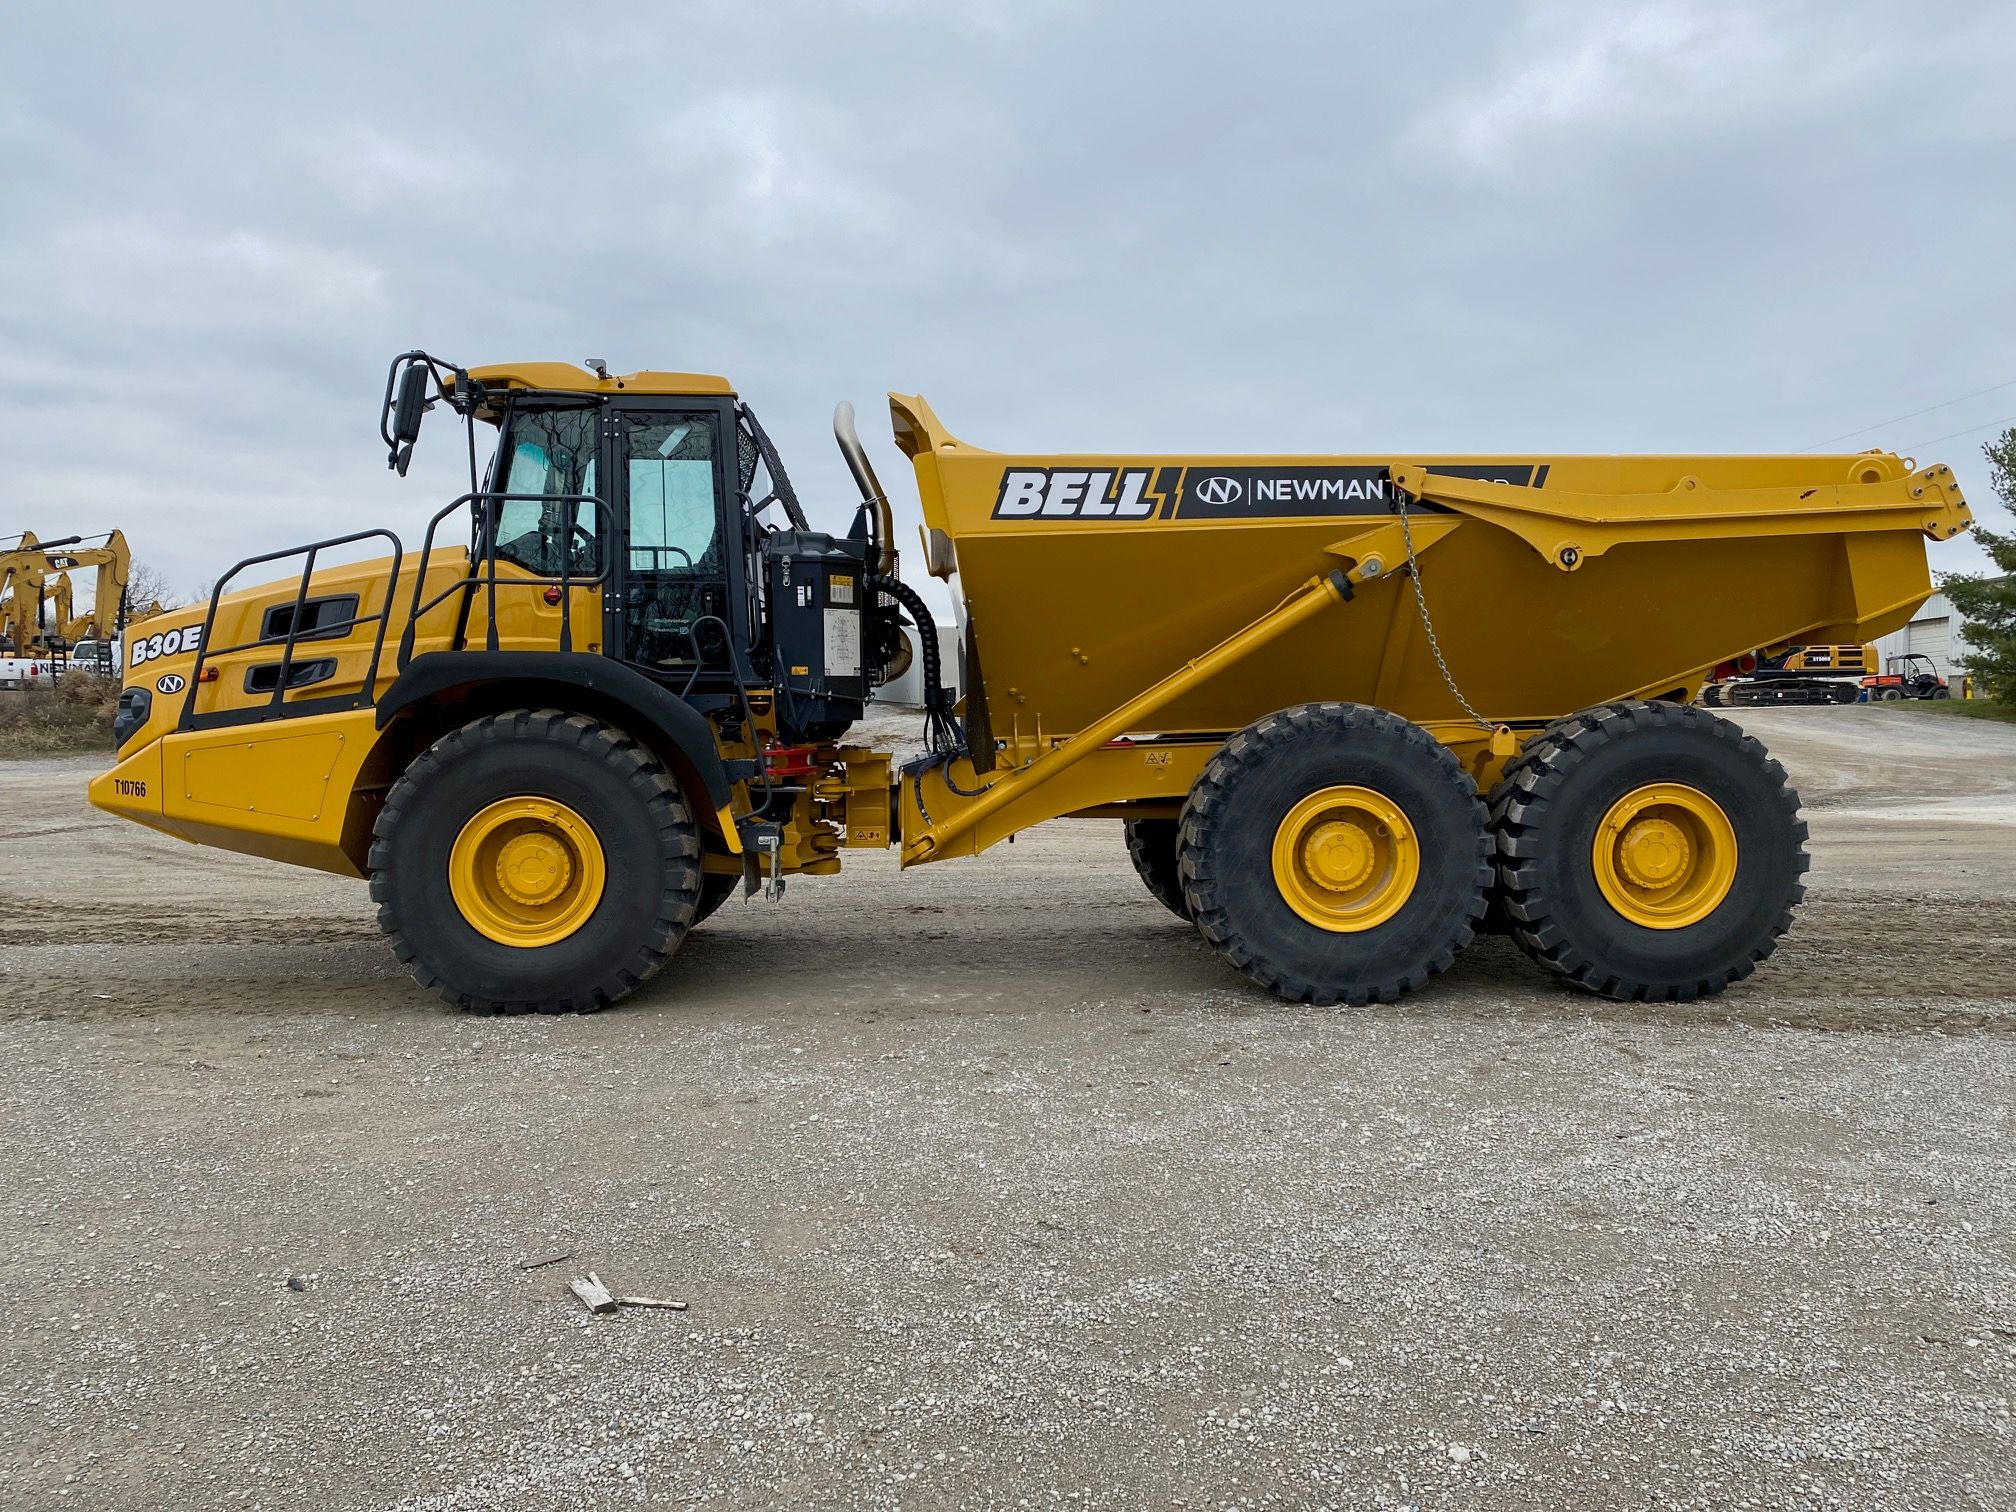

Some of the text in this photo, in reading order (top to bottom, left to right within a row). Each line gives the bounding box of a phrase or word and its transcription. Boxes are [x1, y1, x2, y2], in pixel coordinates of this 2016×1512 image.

[998, 472, 1153, 516] BELL
[1257, 479, 1384, 501] NEWMAN
[54, 557, 69, 569] CAT
[131, 625, 203, 667] B30E
[114, 779, 146, 798] T10766
